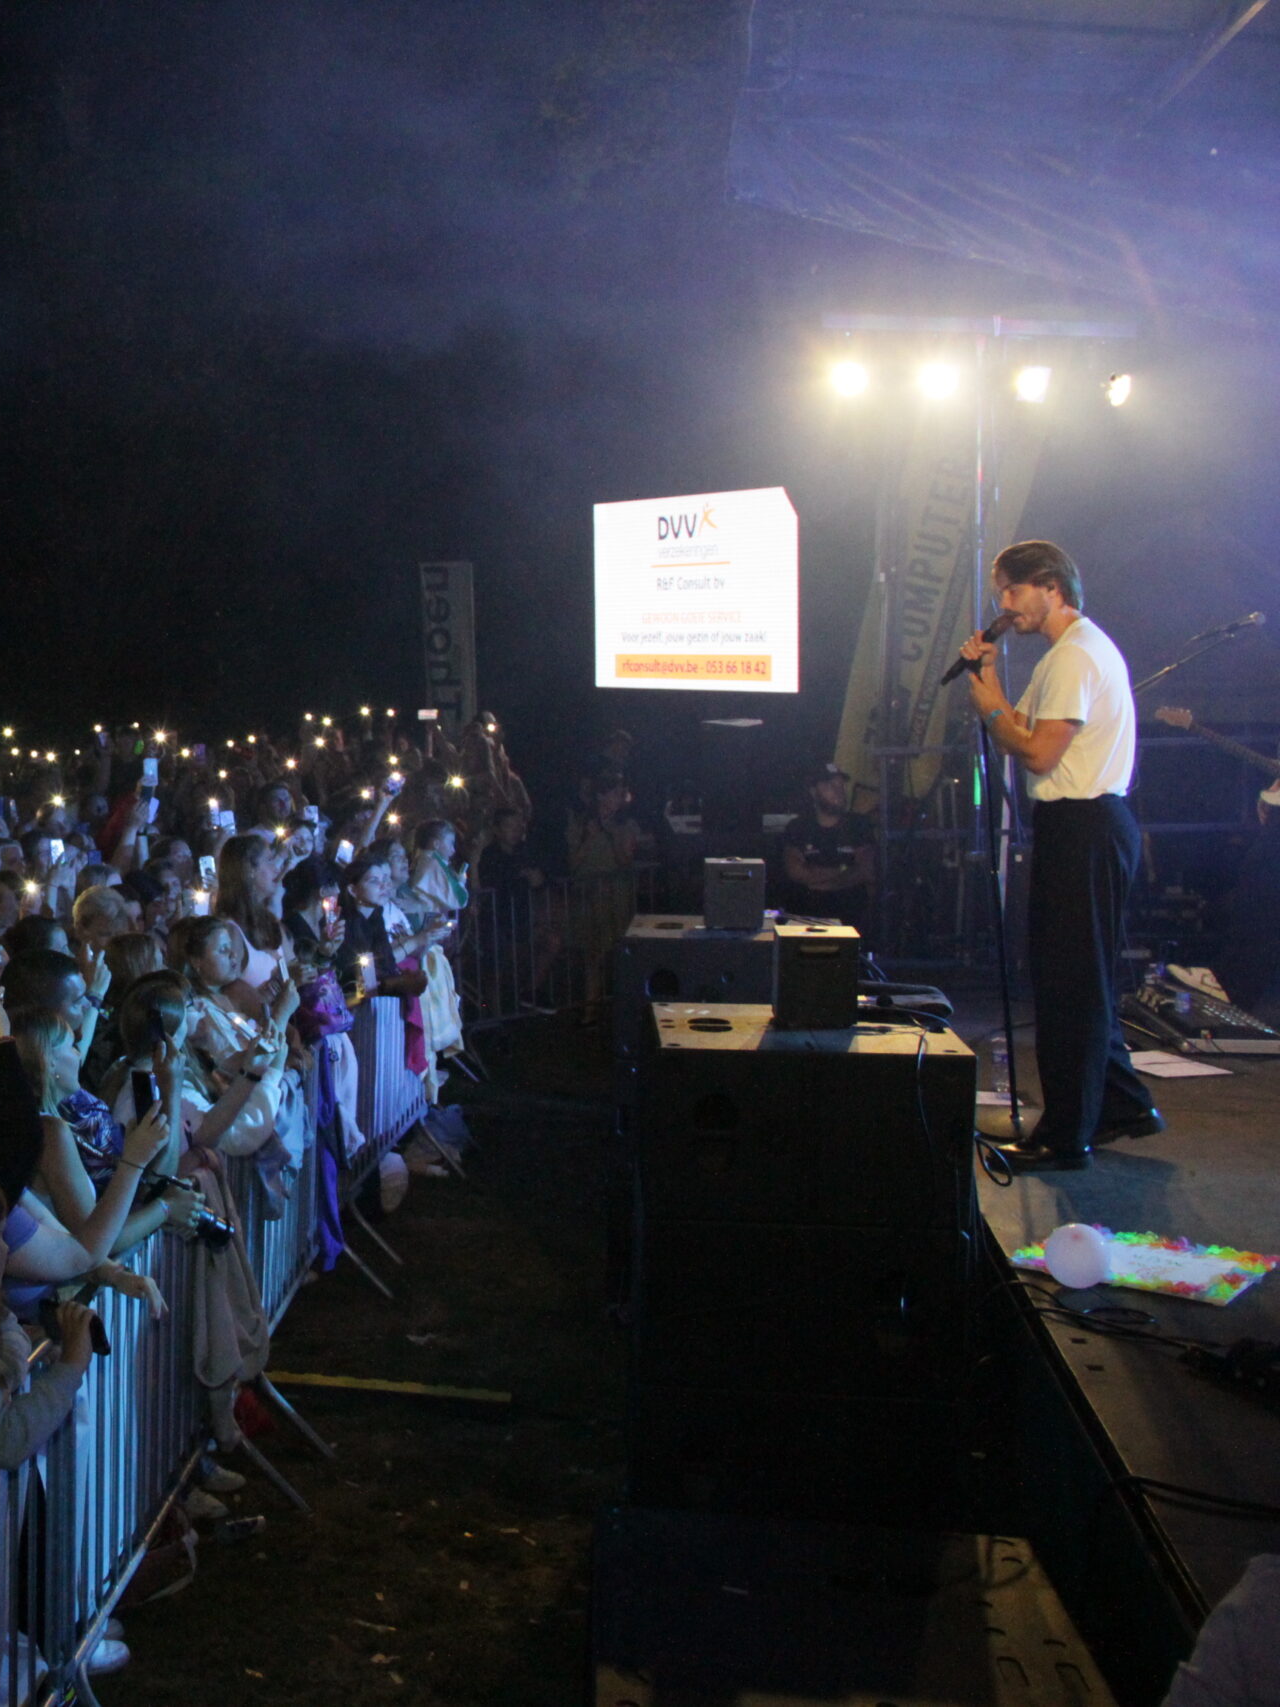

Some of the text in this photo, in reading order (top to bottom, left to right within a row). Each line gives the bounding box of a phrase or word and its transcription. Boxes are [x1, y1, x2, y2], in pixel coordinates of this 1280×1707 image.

[657, 513, 697, 541] DVV
[656, 576, 674, 592] R&F
[677, 576, 711, 591] Consult
[621, 632, 640, 643] Voor
[664, 632, 685, 645] jouw
[686, 632, 709, 645] gezin
[710, 631, 720, 643] of
[720, 632, 742, 646] jouw
[622, 658, 699, 675] rfconsult@dvv.be
[705, 660, 724, 674] 053
[725, 660, 738, 674] 66
[740, 660, 752, 675] 18
[753, 661, 768, 676] 42
